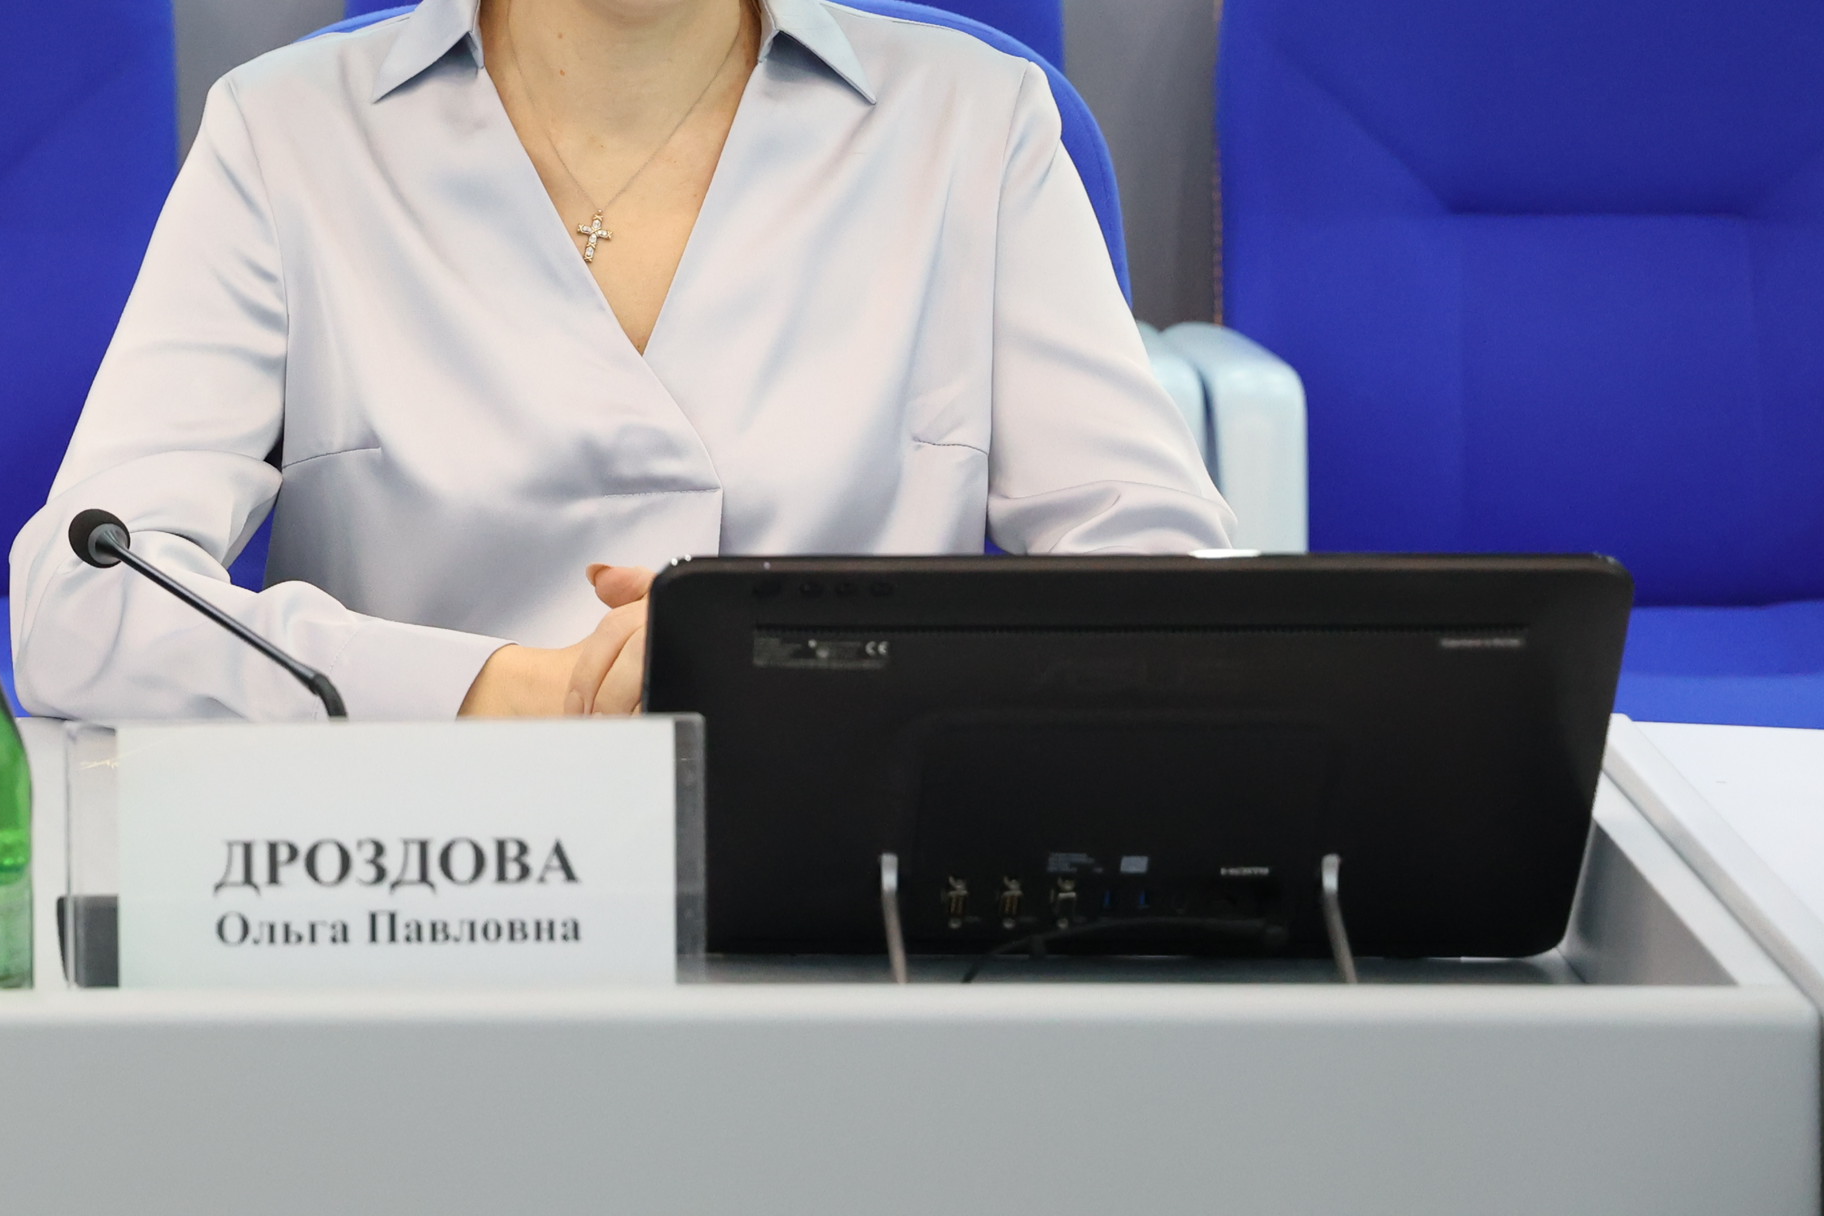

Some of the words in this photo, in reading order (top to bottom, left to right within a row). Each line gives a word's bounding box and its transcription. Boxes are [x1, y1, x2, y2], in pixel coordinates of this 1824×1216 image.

[213, 837, 580, 895] ДРОЗДОВА
[215, 912, 350, 947] Ольга
[368, 911, 581, 945] Павловна
